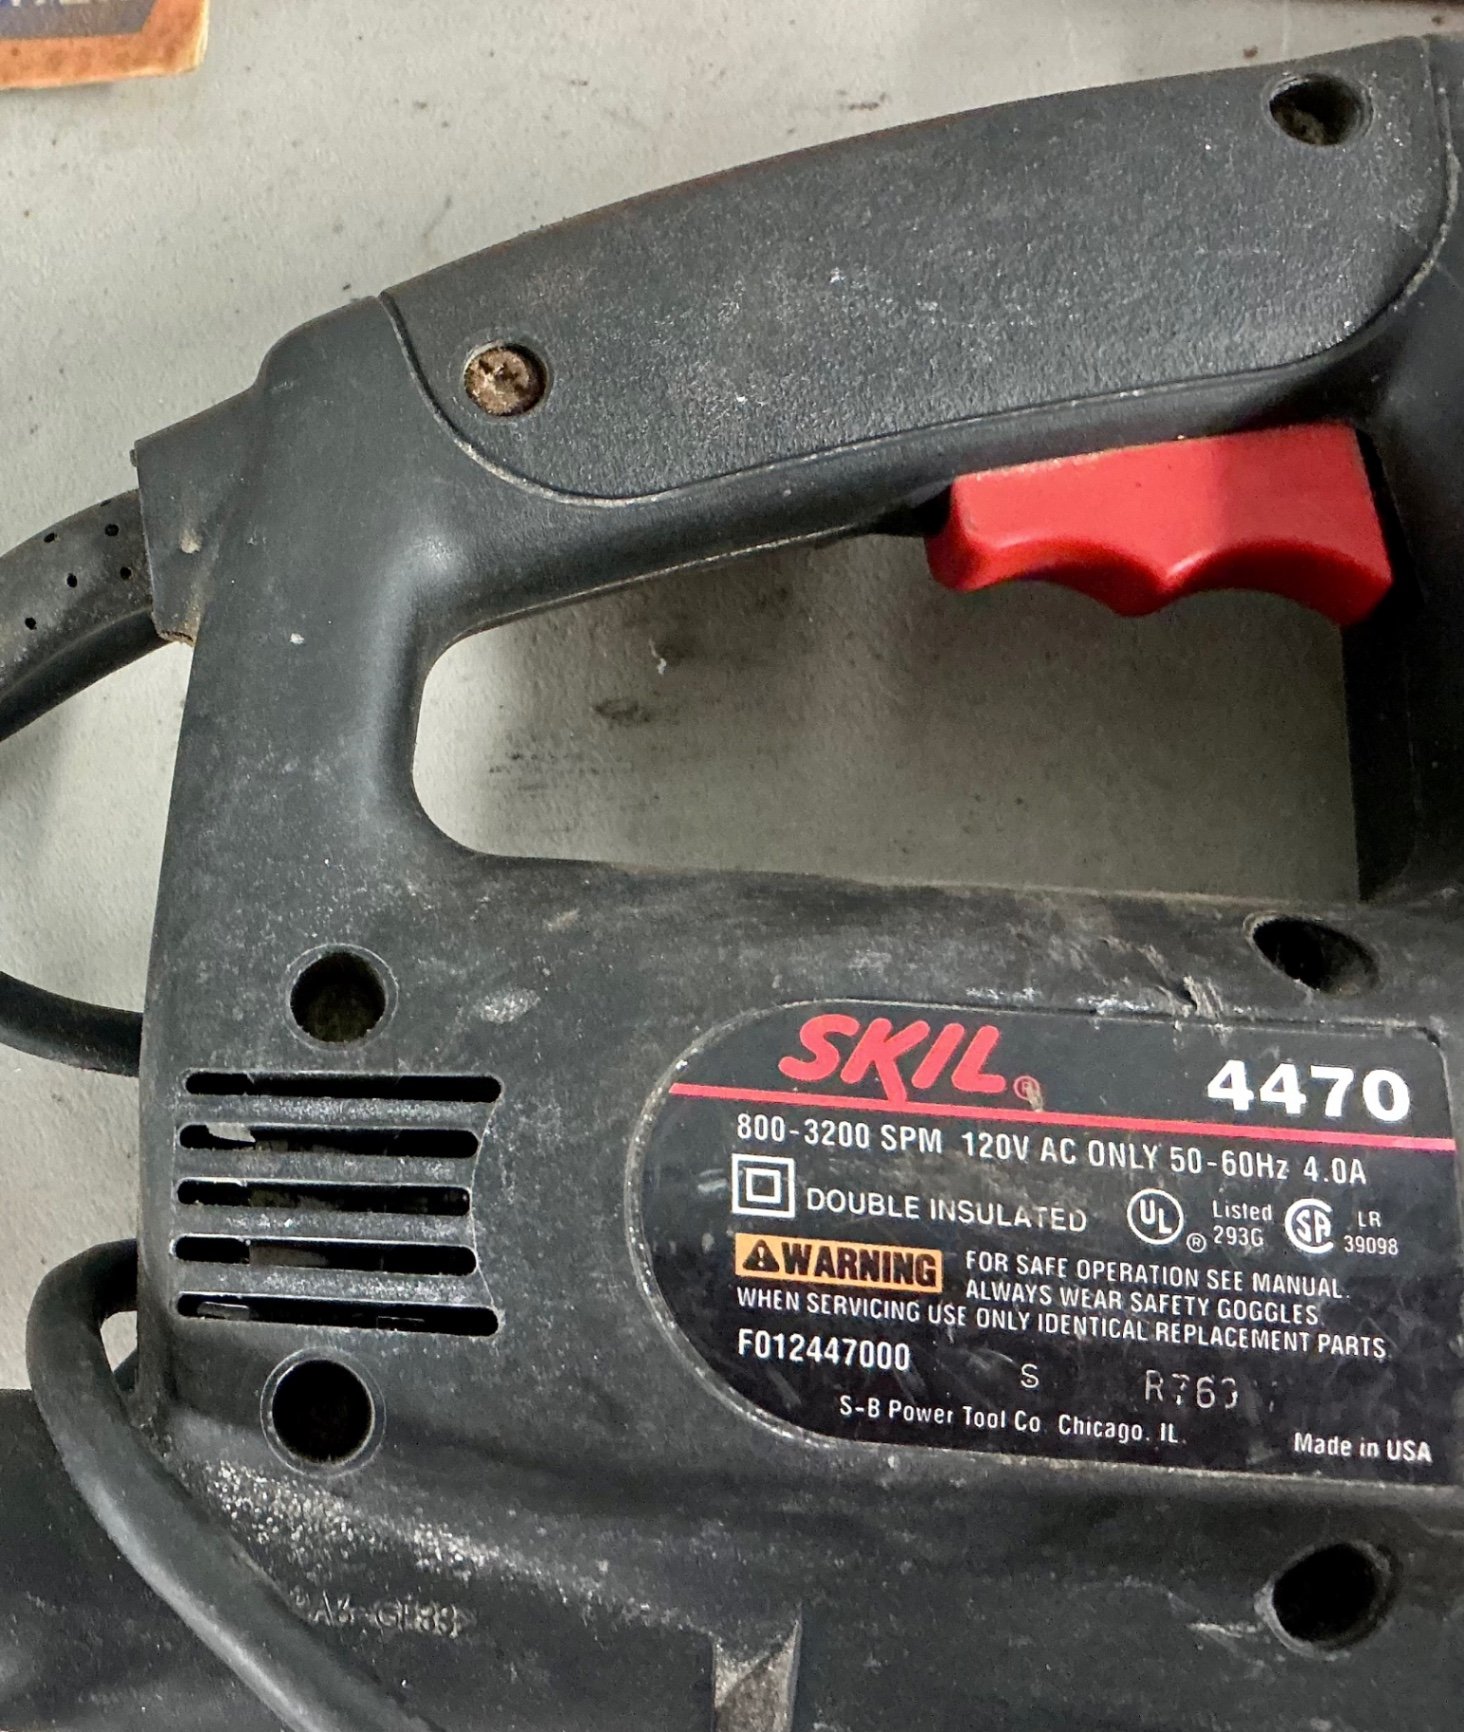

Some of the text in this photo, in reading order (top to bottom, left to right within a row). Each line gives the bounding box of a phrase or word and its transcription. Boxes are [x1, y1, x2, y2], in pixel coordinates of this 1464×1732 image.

[778, 1014, 1007, 1103] SKIL
[1207, 1059, 1411, 1122] 4470
[737, 1112, 1367, 1185] 800-3200 SPM 120V AC ONLY 50-60Hz 4.0A
[806, 1187, 1088, 1232] DOUBLE INSULATED
[1212, 1200, 1273, 1222] Listed
[1357, 1210, 1383, 1229] LR
[1213, 1225, 1264, 1248] 293G
[1342, 1234, 1399, 1256] 39098
[781, 1241, 937, 1288] WARNING
[965, 1250, 1351, 1299] FOR SAFE OPERATION SEE MANUAL.
[736, 1286, 800, 1312] WHEN
[806, 1292, 921, 1322] SERVICING
[928, 1303, 967, 1327] USE
[976, 1306, 1031, 1332] ONLY
[1037, 1312, 1149, 1341] IDENTICAL
[1155, 1321, 1310, 1353] REPLACEMENT
[965, 1279, 1053, 1306] ALWAYS
[1059, 1286, 1123, 1311] WEAR
[1129, 1291, 1210, 1318] SAFETY
[738, 1327, 910, 1372] F012447000
[1020, 1363, 1040, 1389] S
[839, 1394, 881, 1419] S-B
[888, 1400, 954, 1425] Power
[962, 1405, 1006, 1429] Tool
[1294, 1431, 1433, 1465] Made in USA
